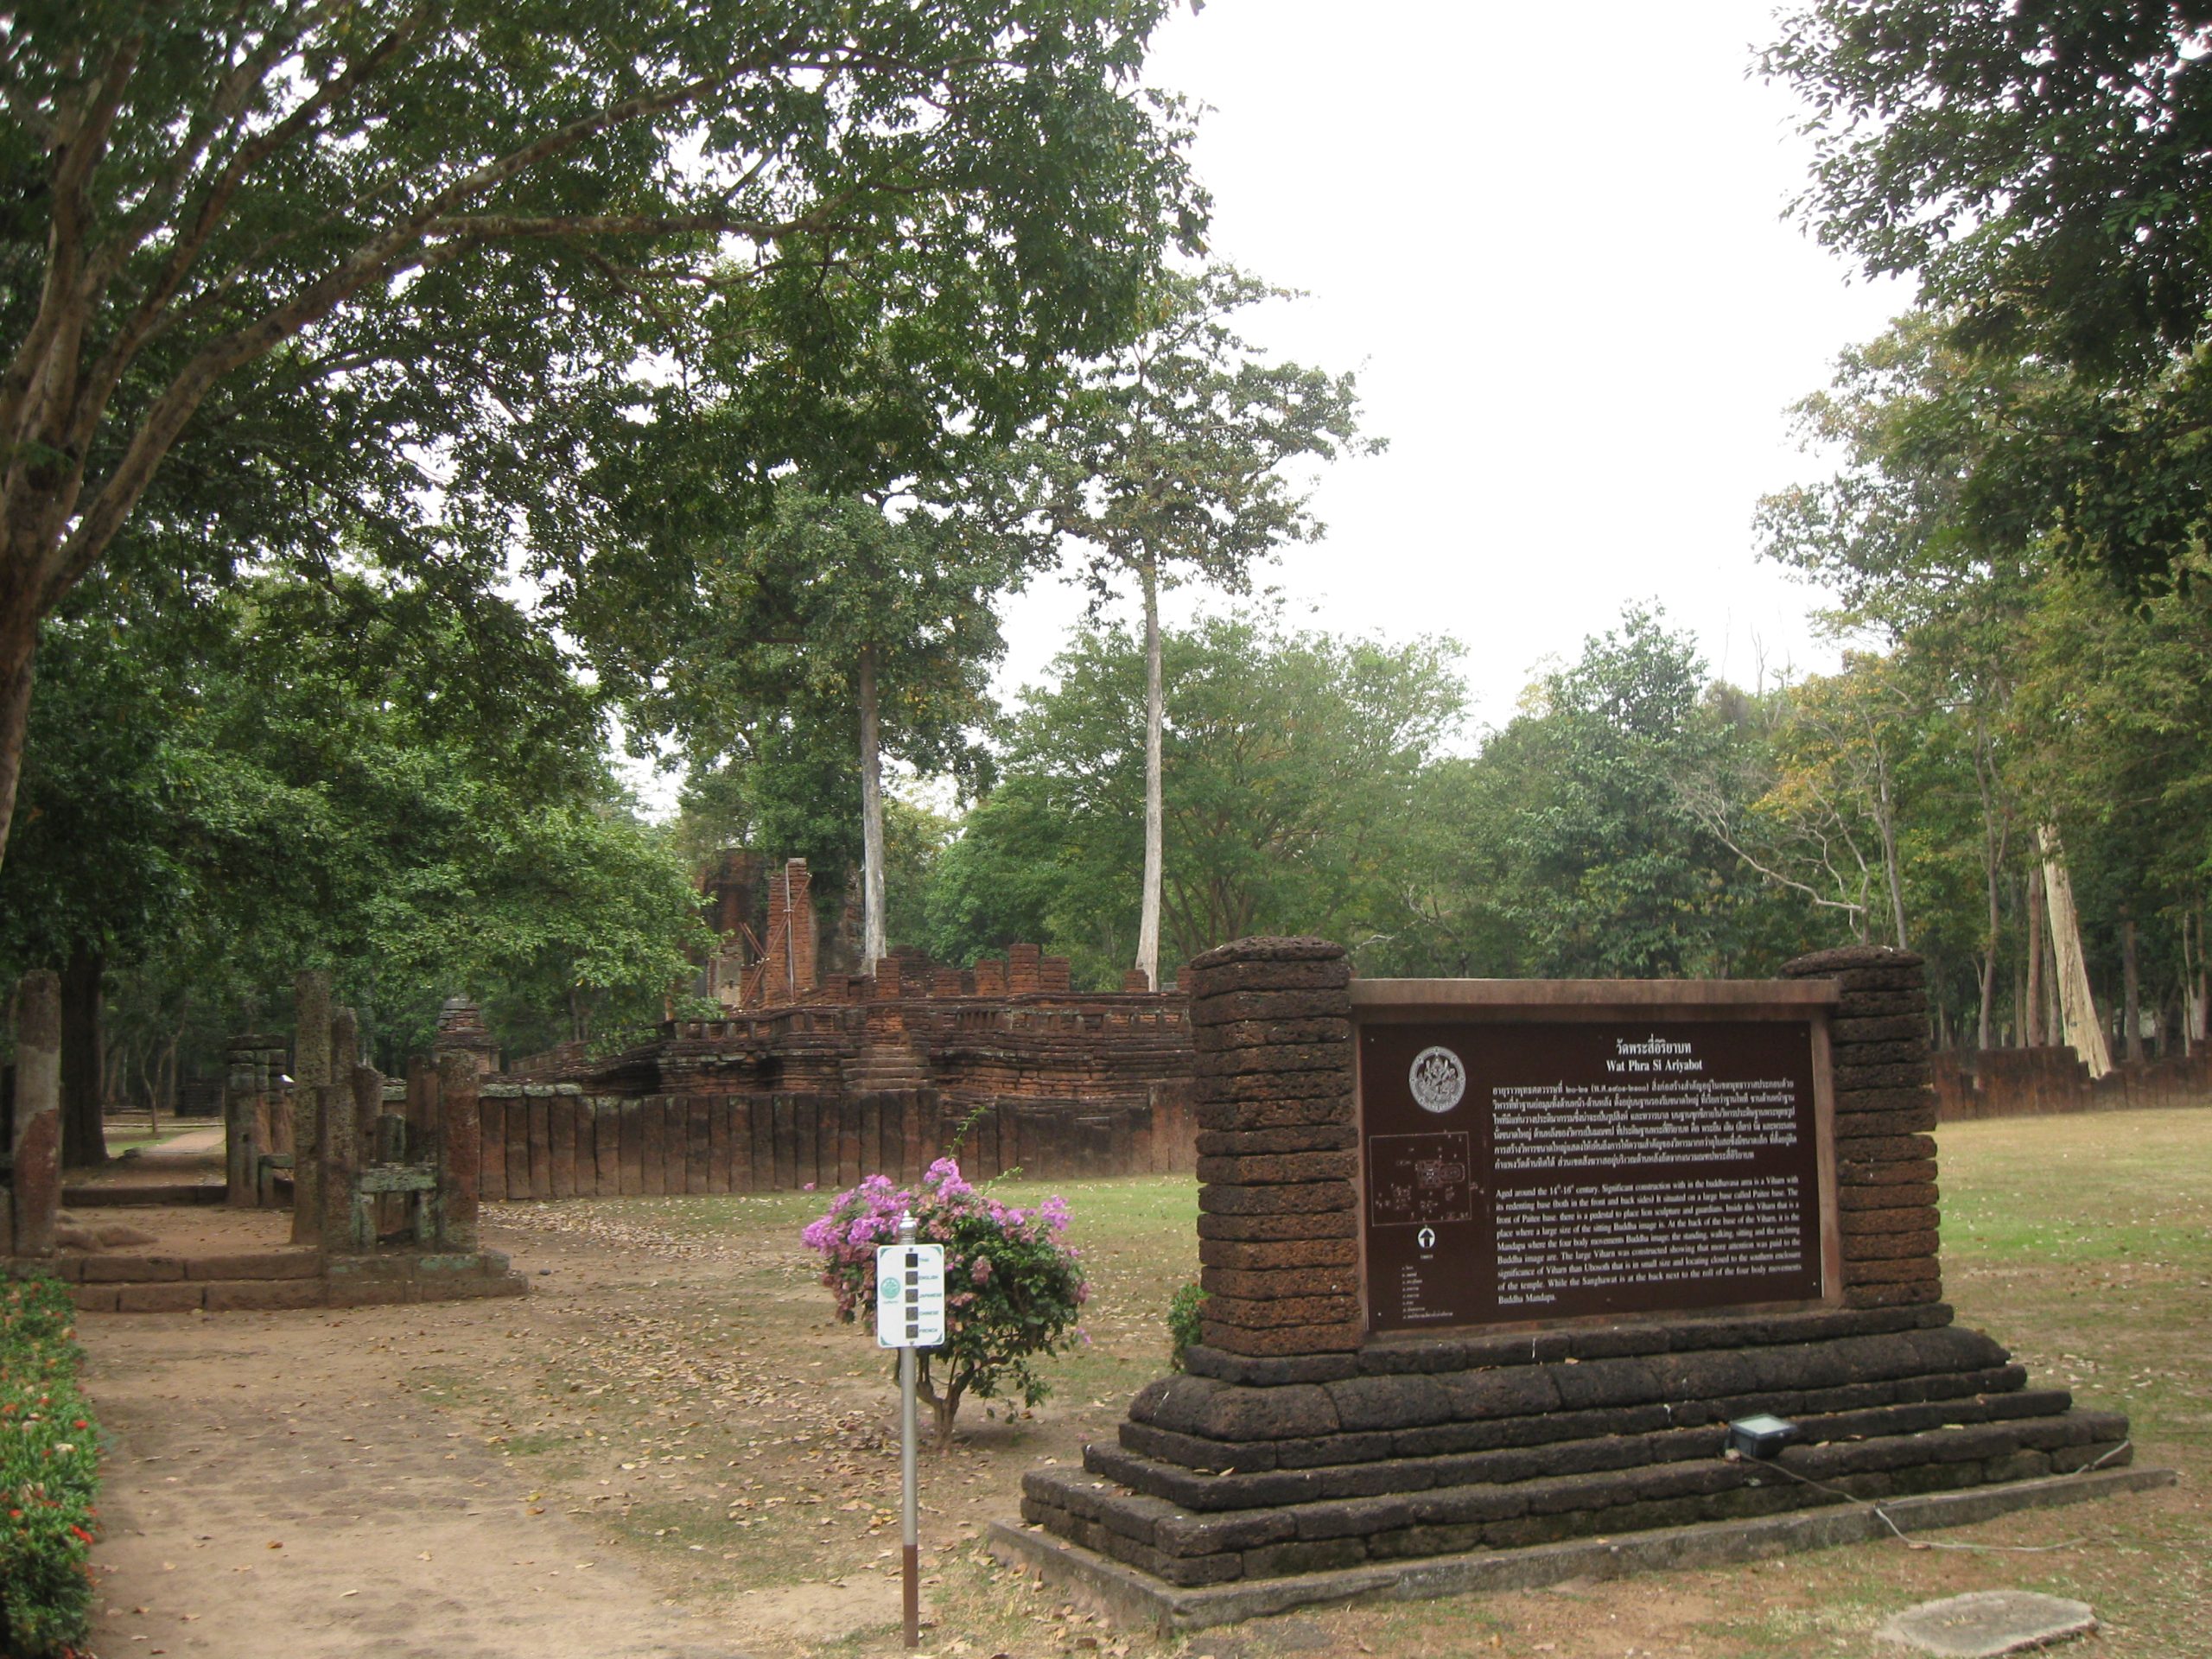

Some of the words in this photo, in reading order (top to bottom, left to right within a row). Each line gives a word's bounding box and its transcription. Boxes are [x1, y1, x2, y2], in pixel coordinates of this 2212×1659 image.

[1606, 1059, 1624, 1071] Wat
[1629, 1059, 1649, 1071] Phra
[1652, 1058, 1662, 1071] Si
[1665, 1058, 1702, 1073] Ariyabot
